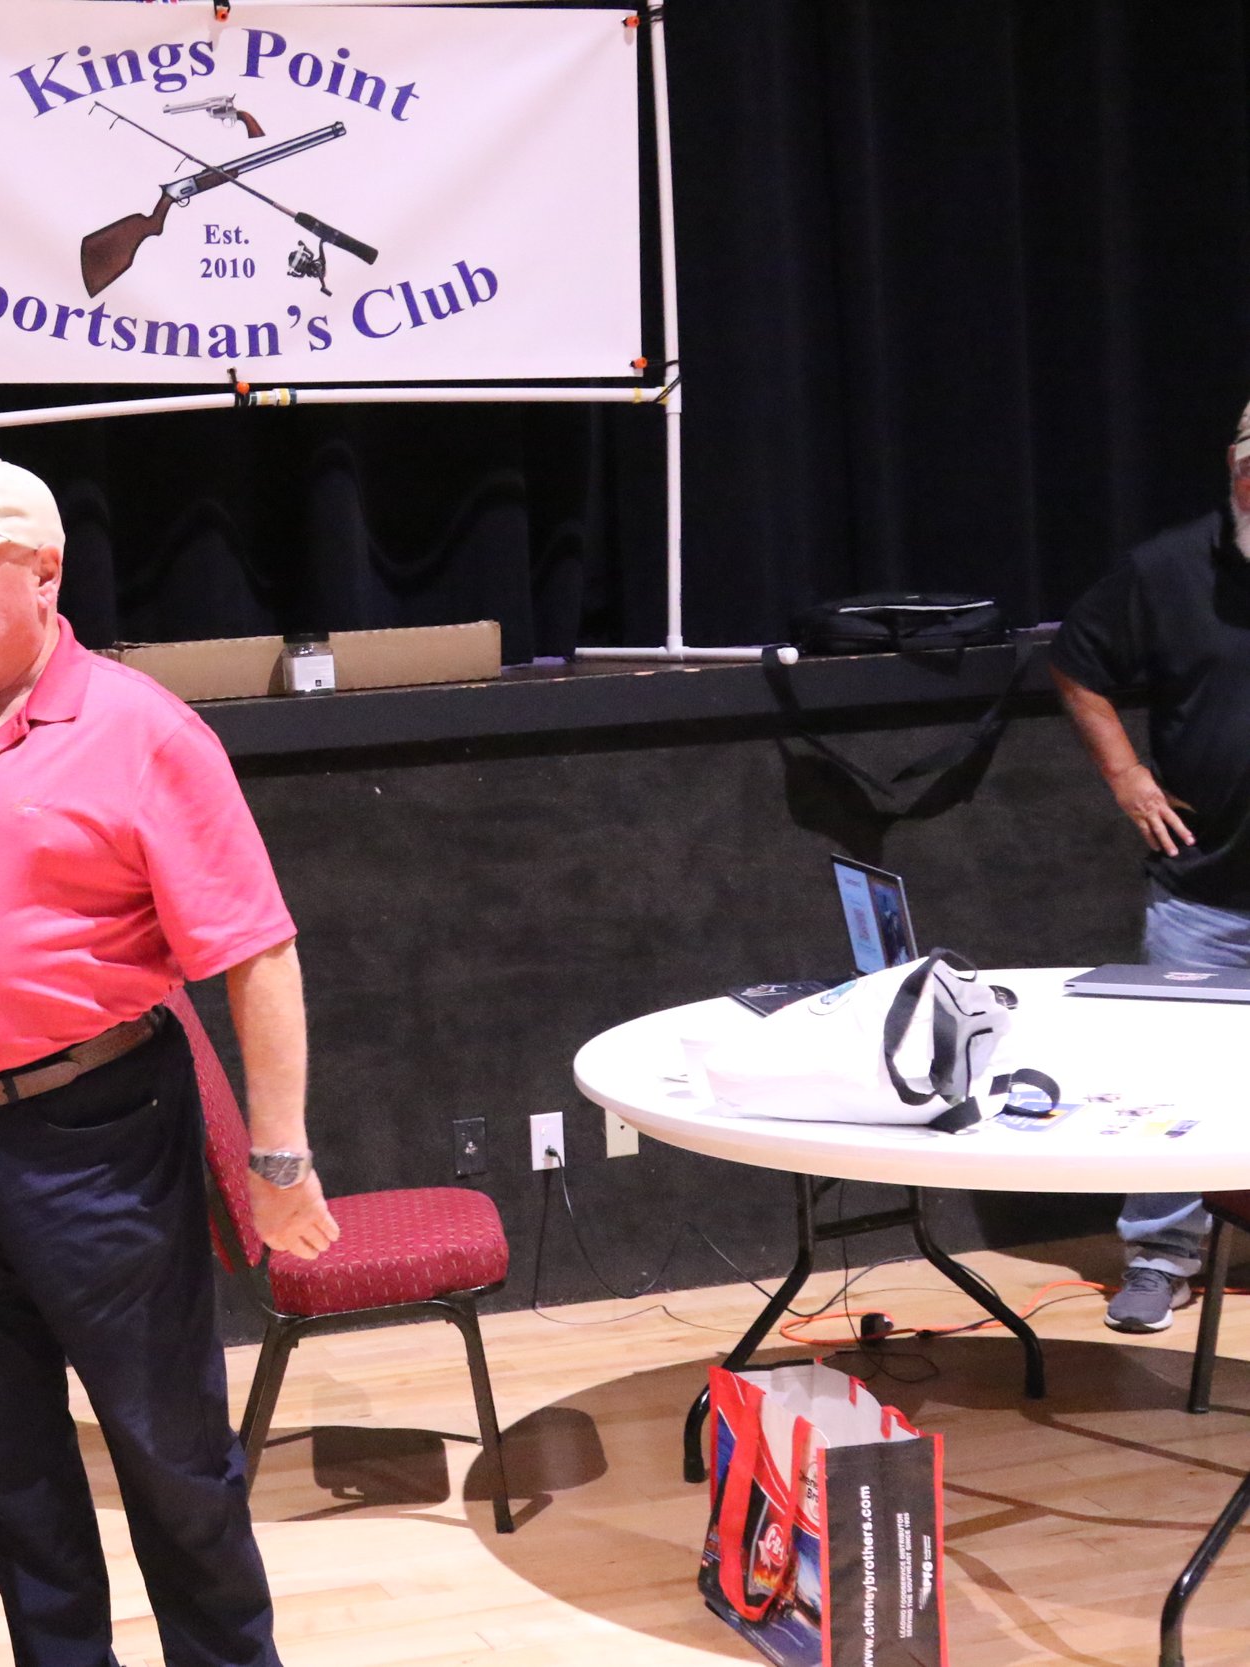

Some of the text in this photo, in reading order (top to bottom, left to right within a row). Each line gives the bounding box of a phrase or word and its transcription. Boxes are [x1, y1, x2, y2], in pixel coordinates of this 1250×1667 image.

[11, 28, 422, 123] Kings Point
[203, 223, 250, 246] Est.
[200, 256, 256, 279] 2010
[352, 259, 500, 340] Club
